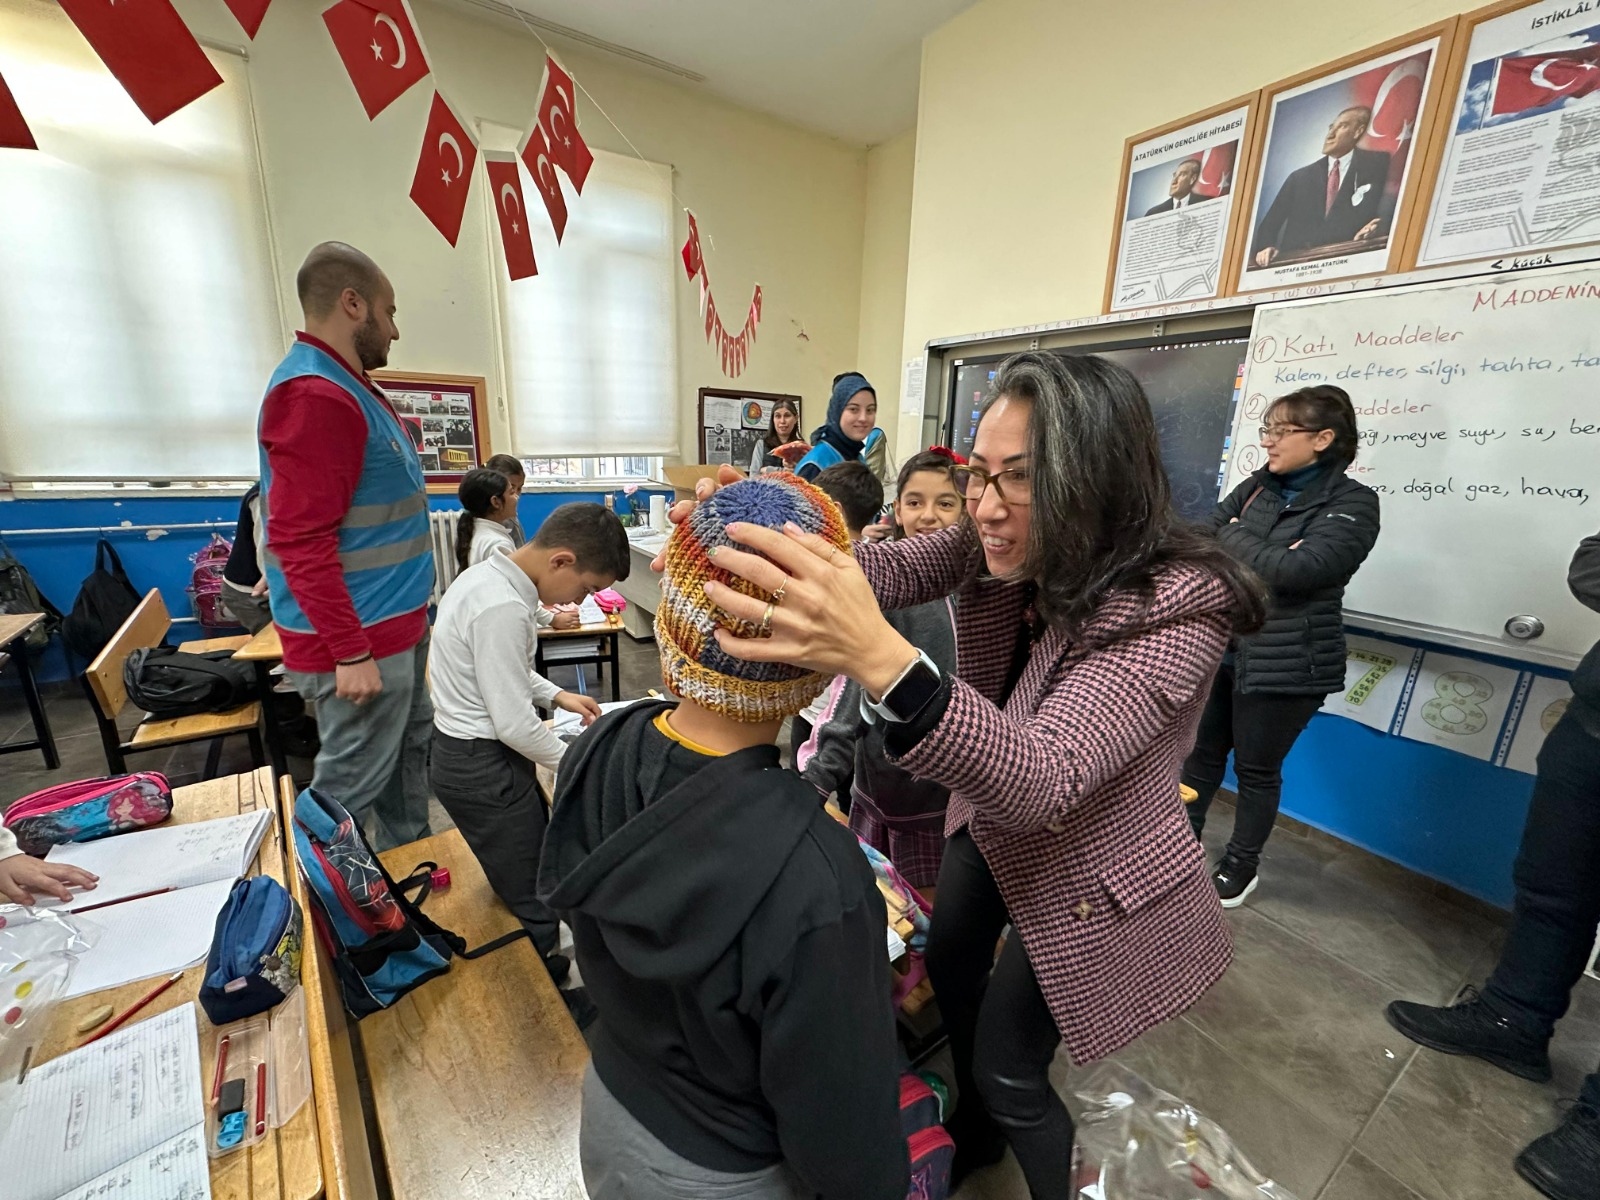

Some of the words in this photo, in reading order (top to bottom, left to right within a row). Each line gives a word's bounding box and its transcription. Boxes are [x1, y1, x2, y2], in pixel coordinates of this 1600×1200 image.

[1531, 2, 1592, 29] İSTİKLÂL
[1134, 143, 1174, 162] ATATÜRK'ÜN
[1174, 131, 1208, 149] GENÇLİĞE
[1209, 117, 1243, 137] HİTABESİ
[1274, 265, 1300, 275] MUSTAFA
[1300, 262, 1320, 272] KEMAL
[1321, 258, 1349, 269] ATATÜRK
[1510, 253, 1553, 270] küçük
[1472, 280, 1600, 312] MADDENİN
[1283, 335, 1334, 357] Katı
[1354, 324, 1465, 347] Maddeler
[1336, 363, 1408, 381] defter,
[1415, 358, 1466, 385] silgi,
[1479, 357, 1564, 373] tahta,
[1353, 399, 1432, 416] addeler
[1359, 429, 1389, 447] ağı,
[1393, 431, 1448, 448] meyve
[1459, 429, 1506, 446] suyu,
[1521, 428, 1556, 441] su,
[1370, 485, 1395, 495] az,
[1404, 477, 1454, 501] doğal
[1464, 485, 1509, 501] gaz,
[1521, 476, 1589, 506] hava,
